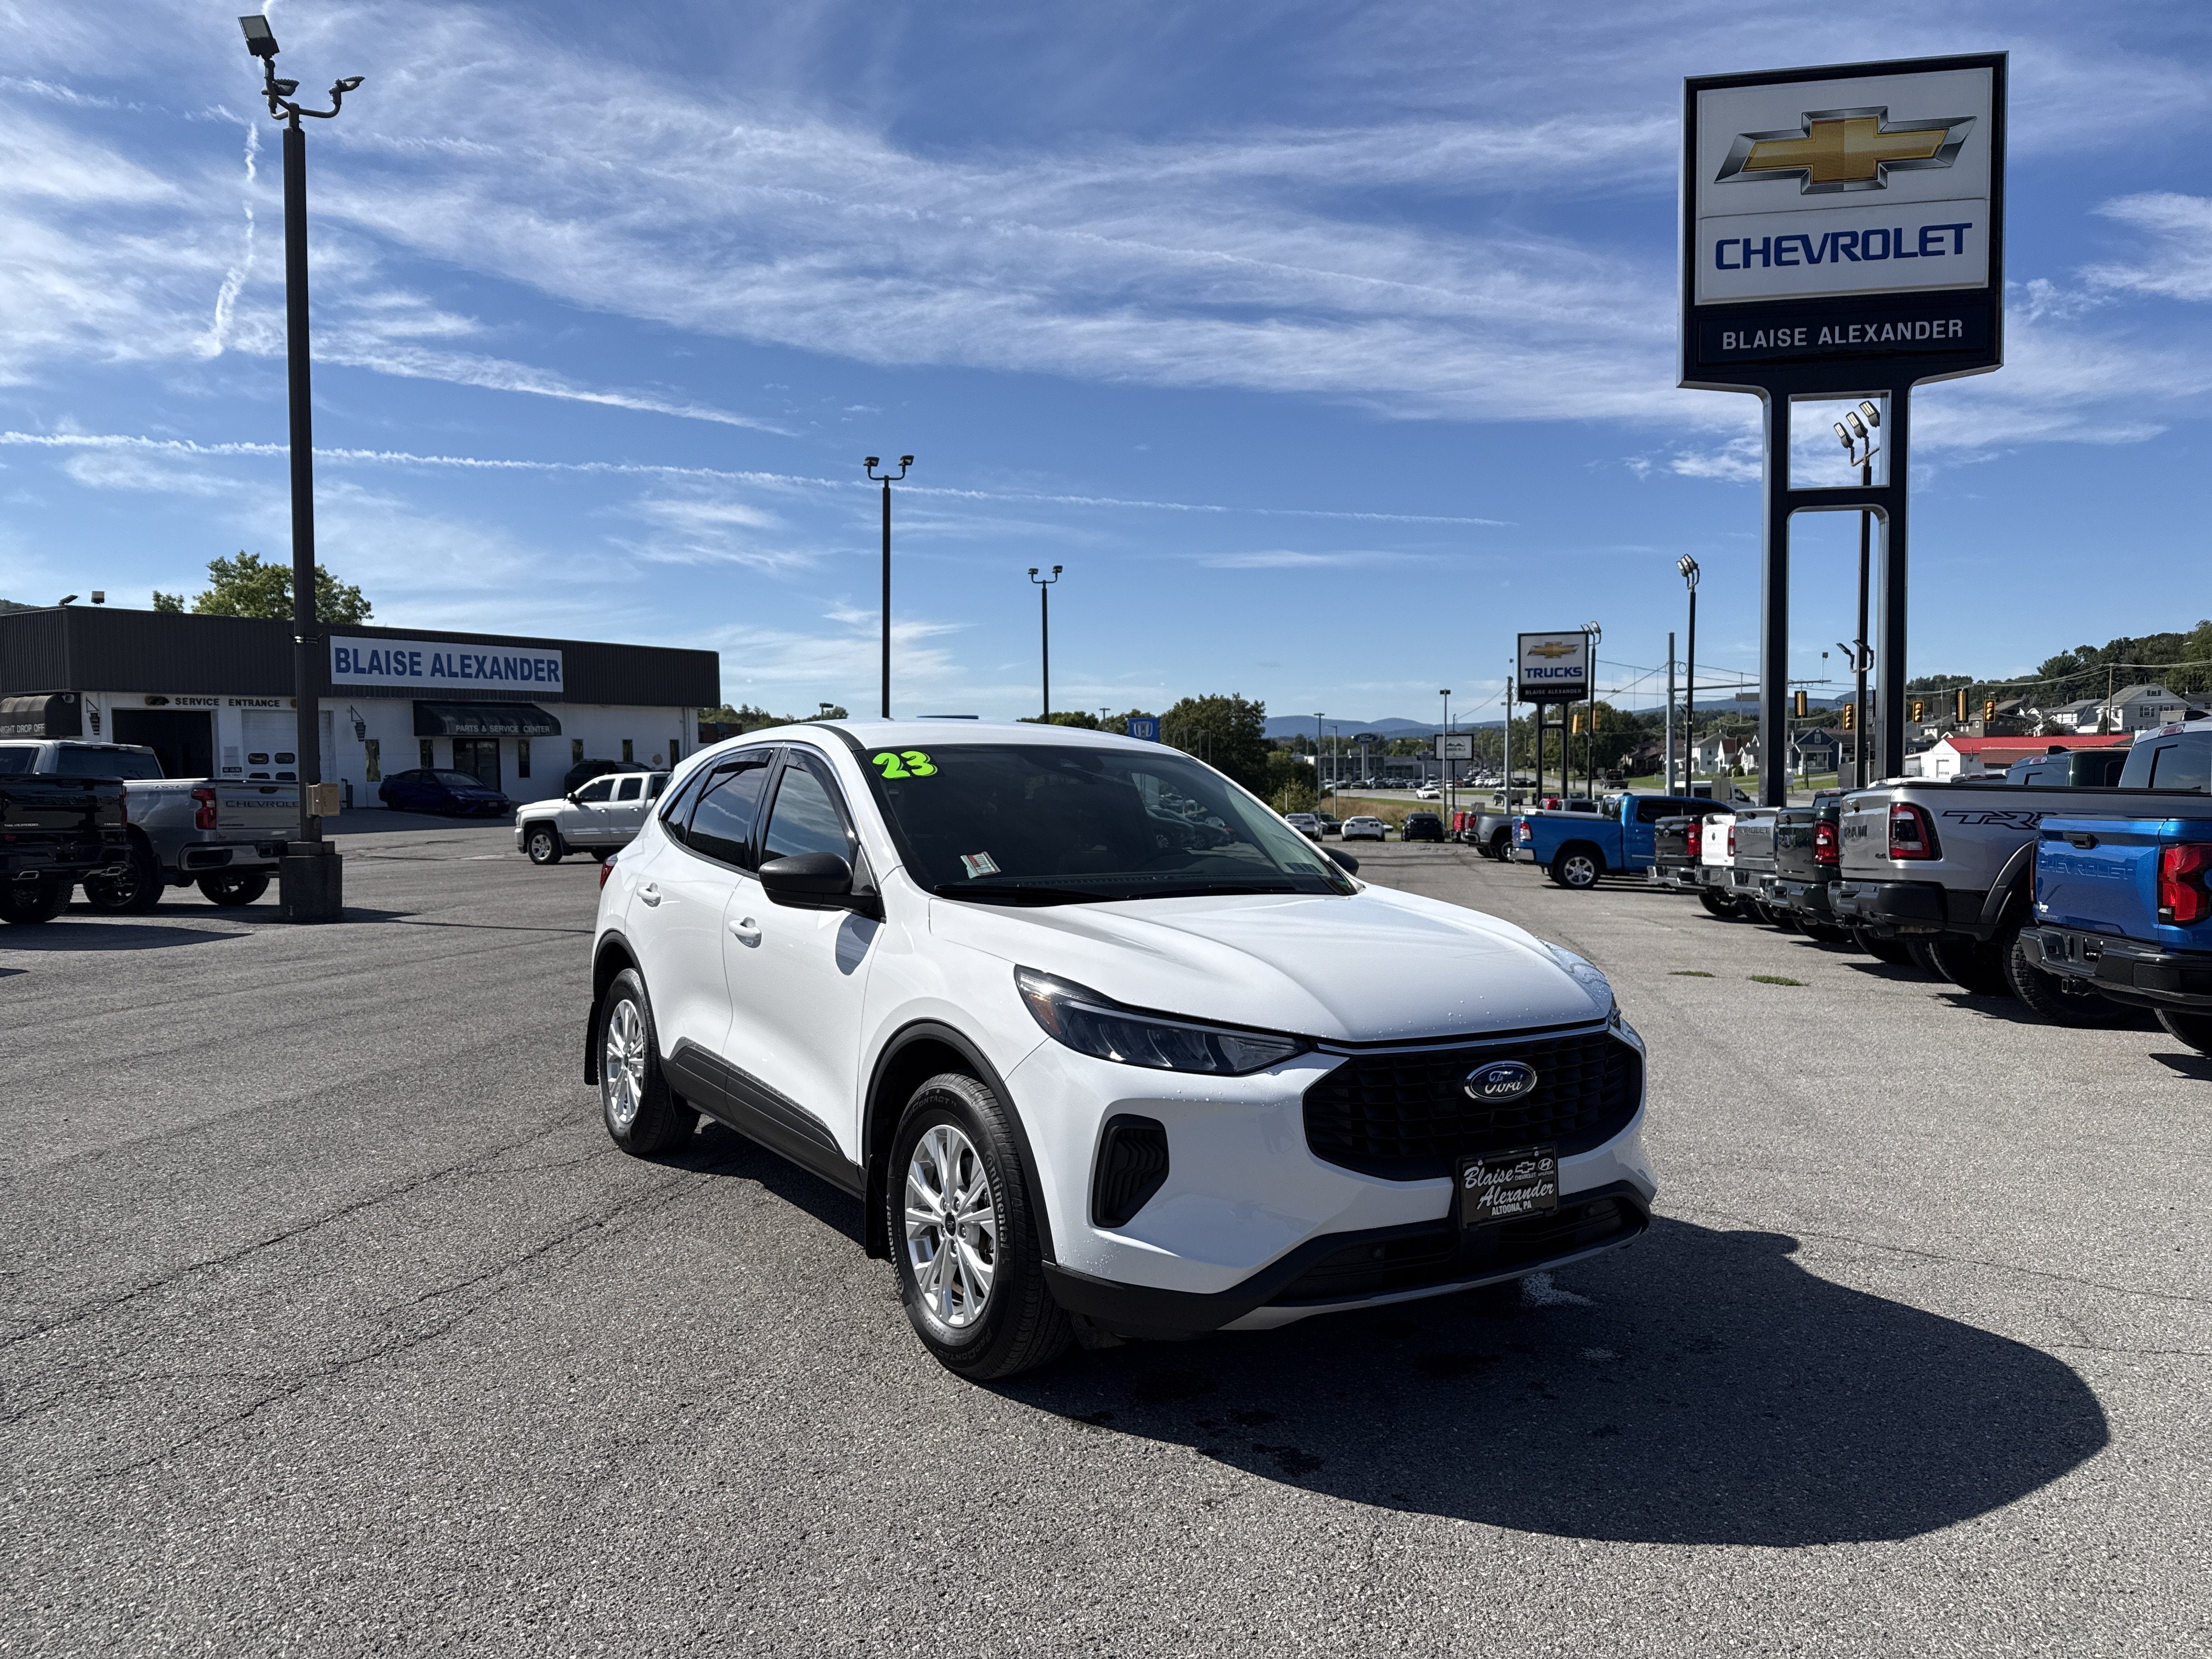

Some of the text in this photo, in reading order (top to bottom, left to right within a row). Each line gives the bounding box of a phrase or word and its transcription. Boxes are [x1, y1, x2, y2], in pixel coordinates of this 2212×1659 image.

[1715, 222, 1973, 270] CHEVROLET
[1723, 319, 1963, 349] BLAISE ALEXANDER
[334, 647, 561, 682] BLAISE ALEXANDER
[1525, 667, 1582, 678] TRUCKS
[175, 697, 280, 707] SERVICE ENTRANCE
[16, 724, 32, 733] DROP
[33, 723, 45, 732] OFF
[872, 751, 938, 778] 23
[1844, 825, 1867, 838] RAM
[2039, 860, 2134, 880] CHEVROLET
[1485, 1070, 1523, 1094] Ford
[1464, 1166, 1514, 1189] Blaise
[1515, 1172, 1537, 1180] CHEVROLET
[1477, 1179, 1554, 1210] Alexander
[1492, 1200, 1532, 1216] ALTOONA, PA
